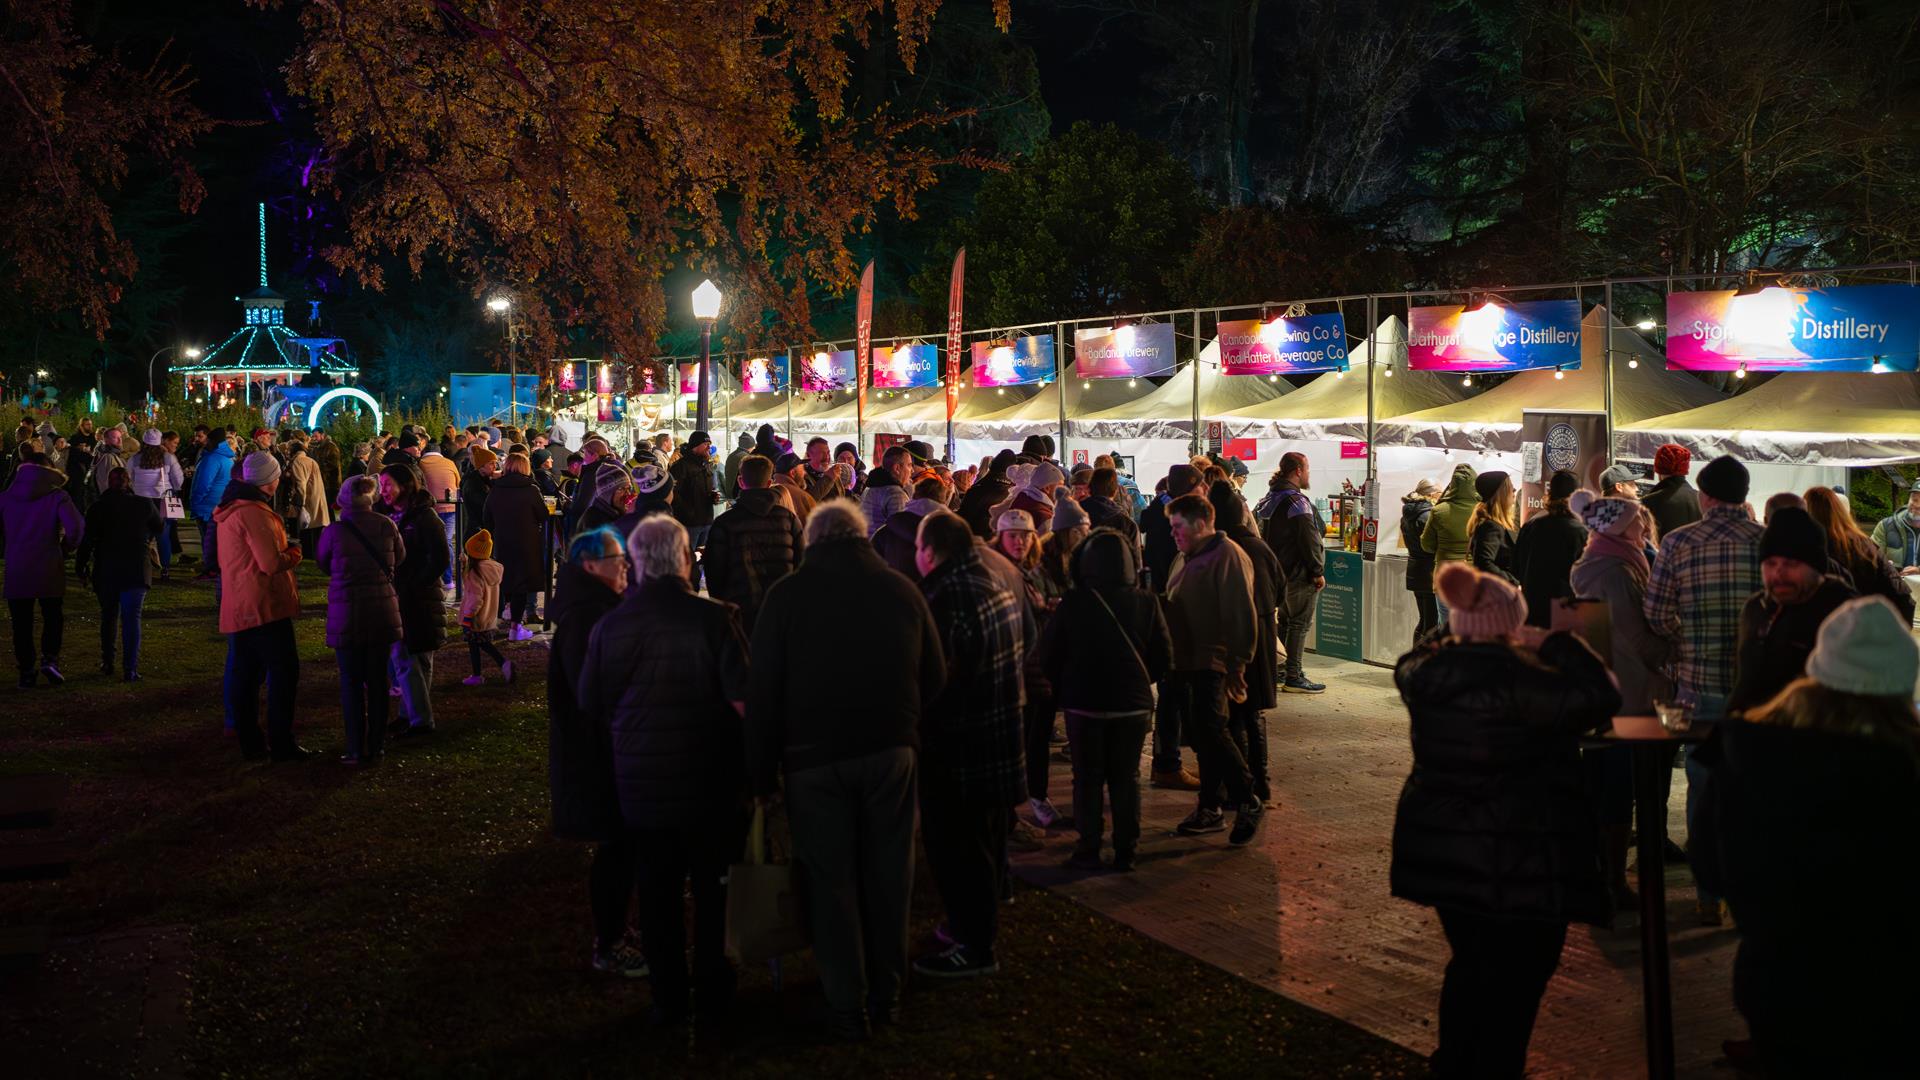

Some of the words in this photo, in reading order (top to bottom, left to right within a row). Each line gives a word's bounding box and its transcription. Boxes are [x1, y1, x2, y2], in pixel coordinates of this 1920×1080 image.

[1312, 326, 1329, 340] Co
[1332, 324, 1340, 338] &
[1520, 327, 1579, 347] Distillery
[1802, 317, 1888, 342] Distillery
[1326, 344, 1344, 359] Co
[921, 359, 931, 371] Co
[1527, 496, 1544, 509] Hot
